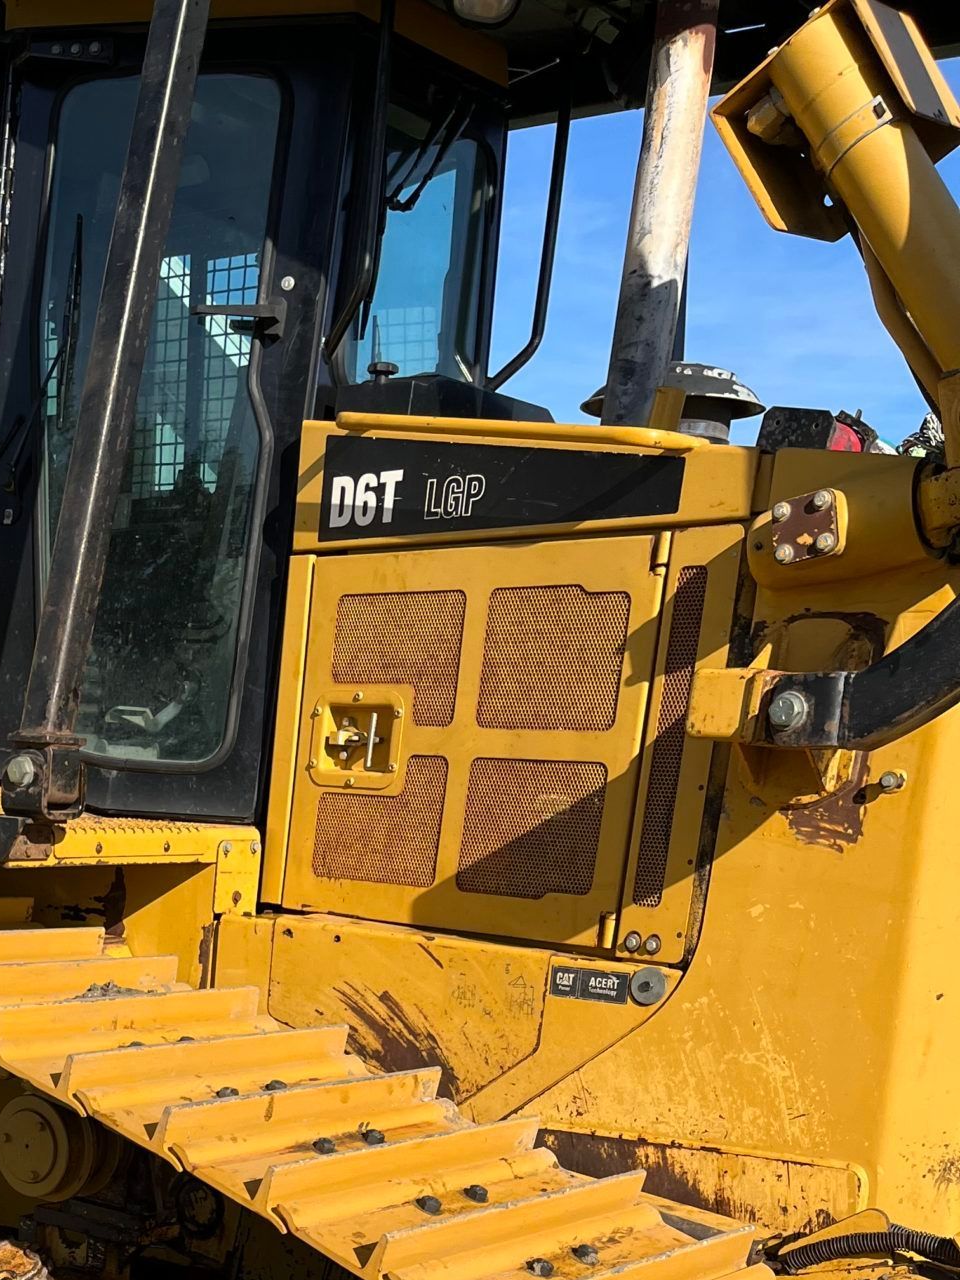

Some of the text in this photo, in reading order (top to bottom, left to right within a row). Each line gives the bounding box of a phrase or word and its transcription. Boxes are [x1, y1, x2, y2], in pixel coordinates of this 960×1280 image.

[329, 469, 486, 528] D6T LGP
[556, 972, 575, 986] CAT
[589, 976, 620, 989] ACERT
